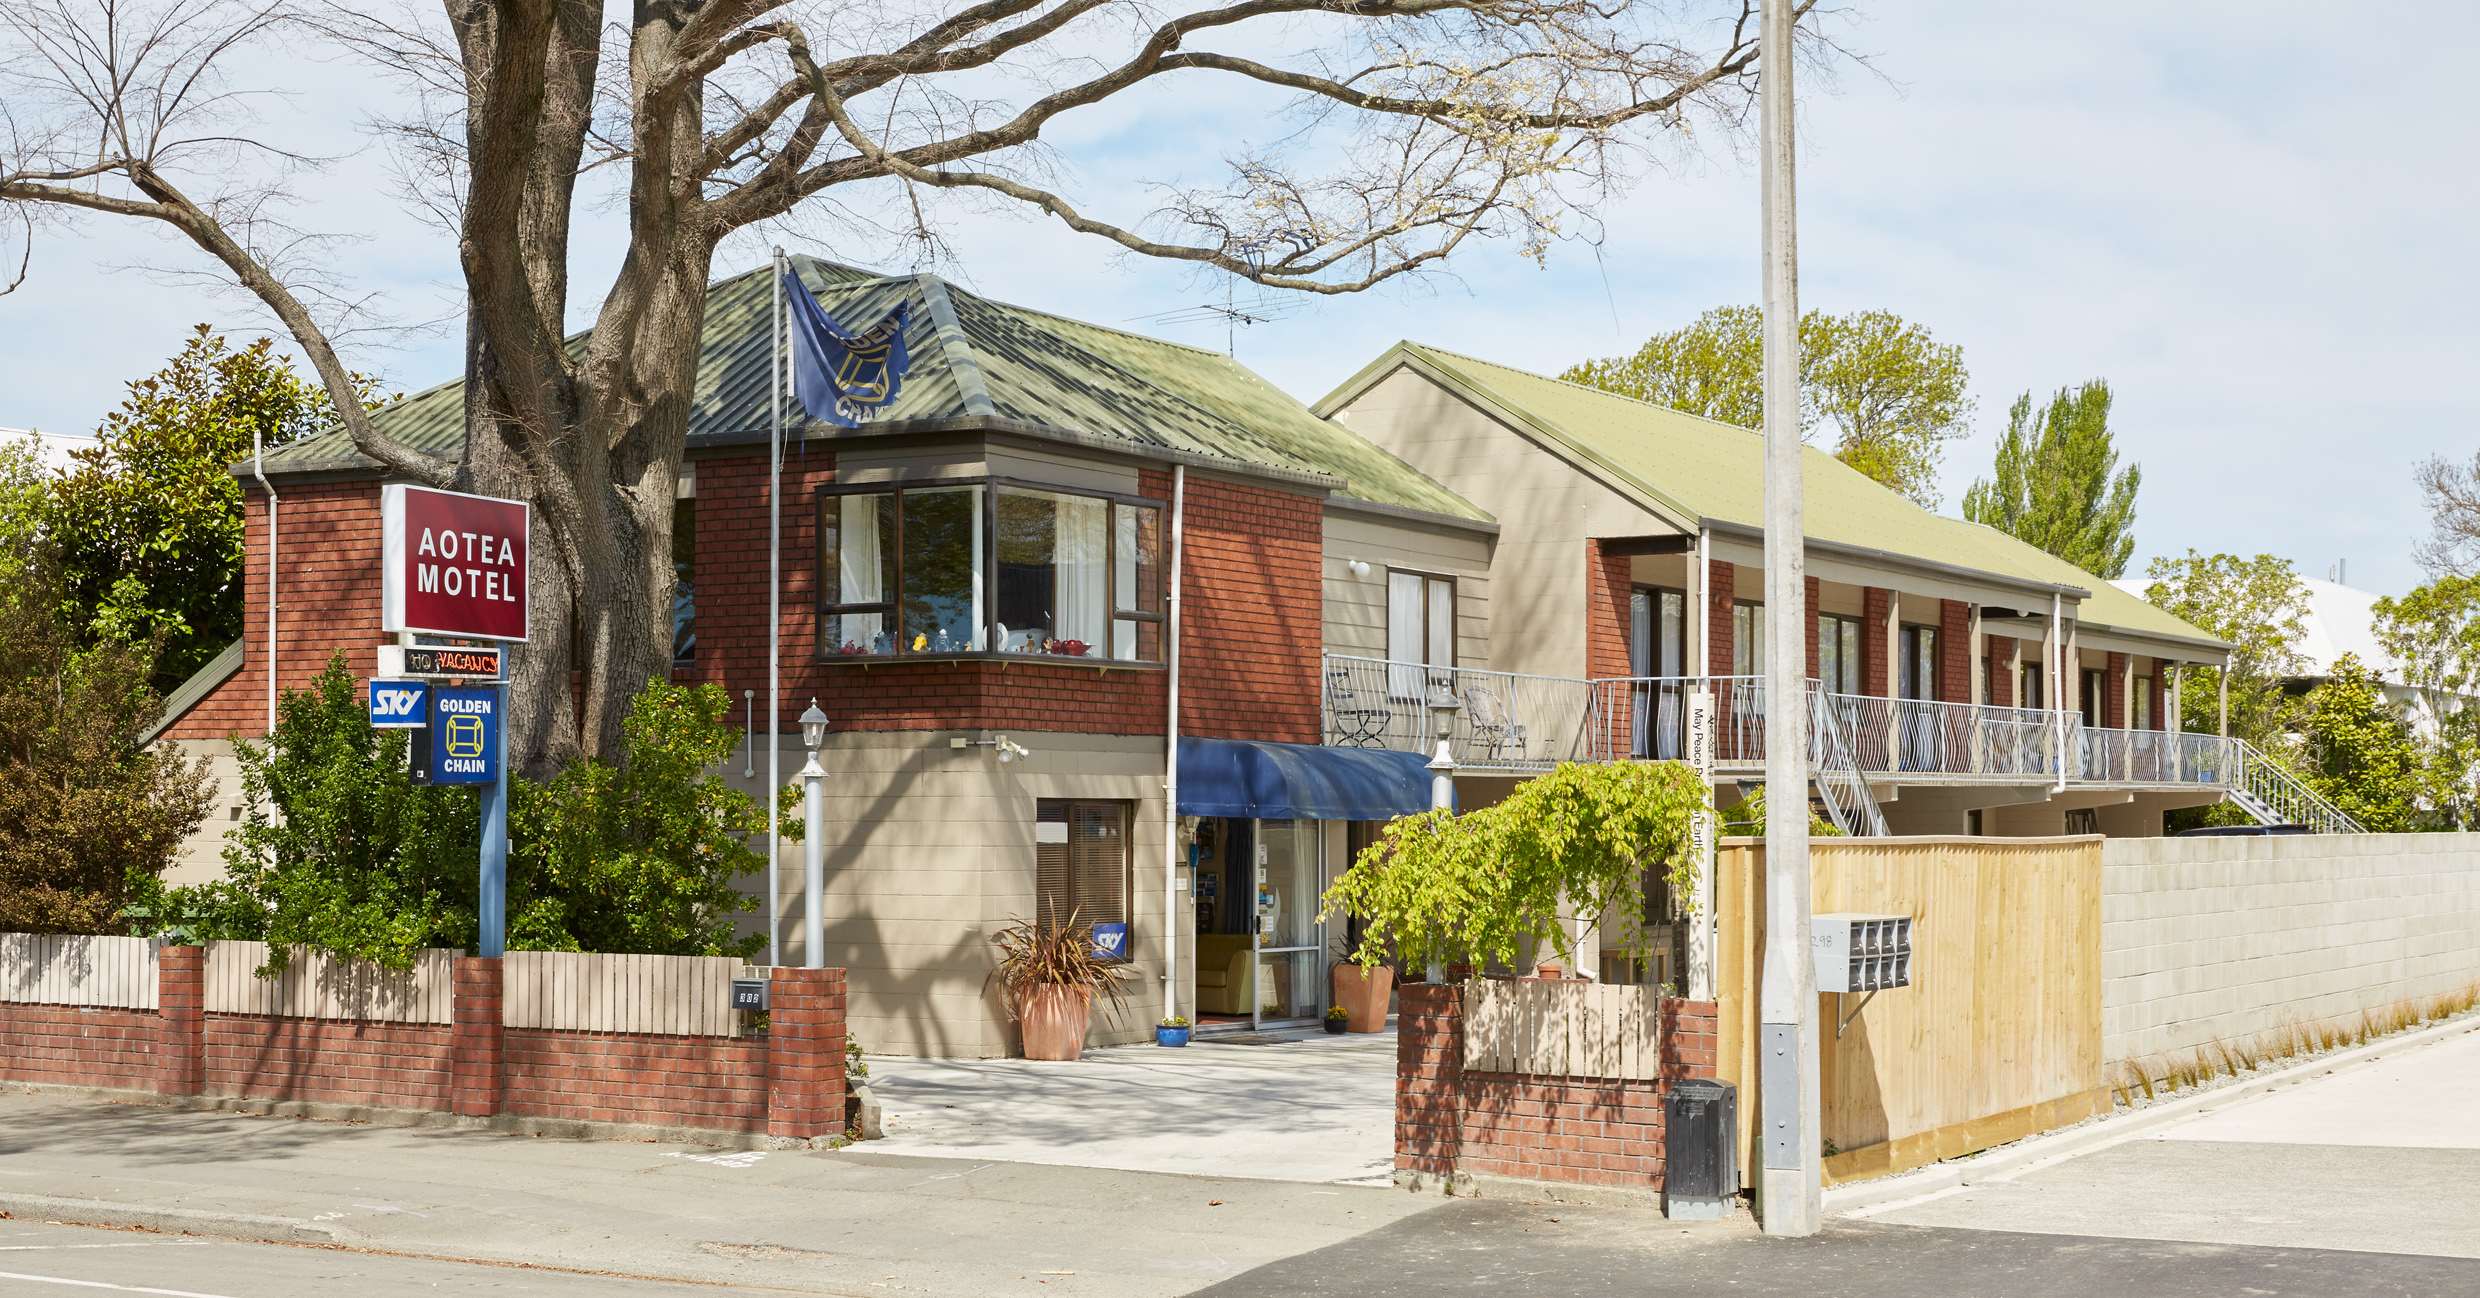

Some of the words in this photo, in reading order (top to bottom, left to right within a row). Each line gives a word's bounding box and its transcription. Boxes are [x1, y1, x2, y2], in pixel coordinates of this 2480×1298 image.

[418, 527, 515, 567] AOTEA
[418, 563, 515, 602] MOTEL
[410, 653, 431, 670] NO
[437, 651, 498, 672] VACANCY
[372, 689, 423, 715] SKY
[440, 698, 491, 714] GOLDEN
[1693, 708, 1703, 729] May
[1694, 733, 1703, 765] Peace
[444, 759, 485, 773] CHAIN
[1693, 822, 1703, 849] Earth
[1811, 935, 1832, 948] 298
